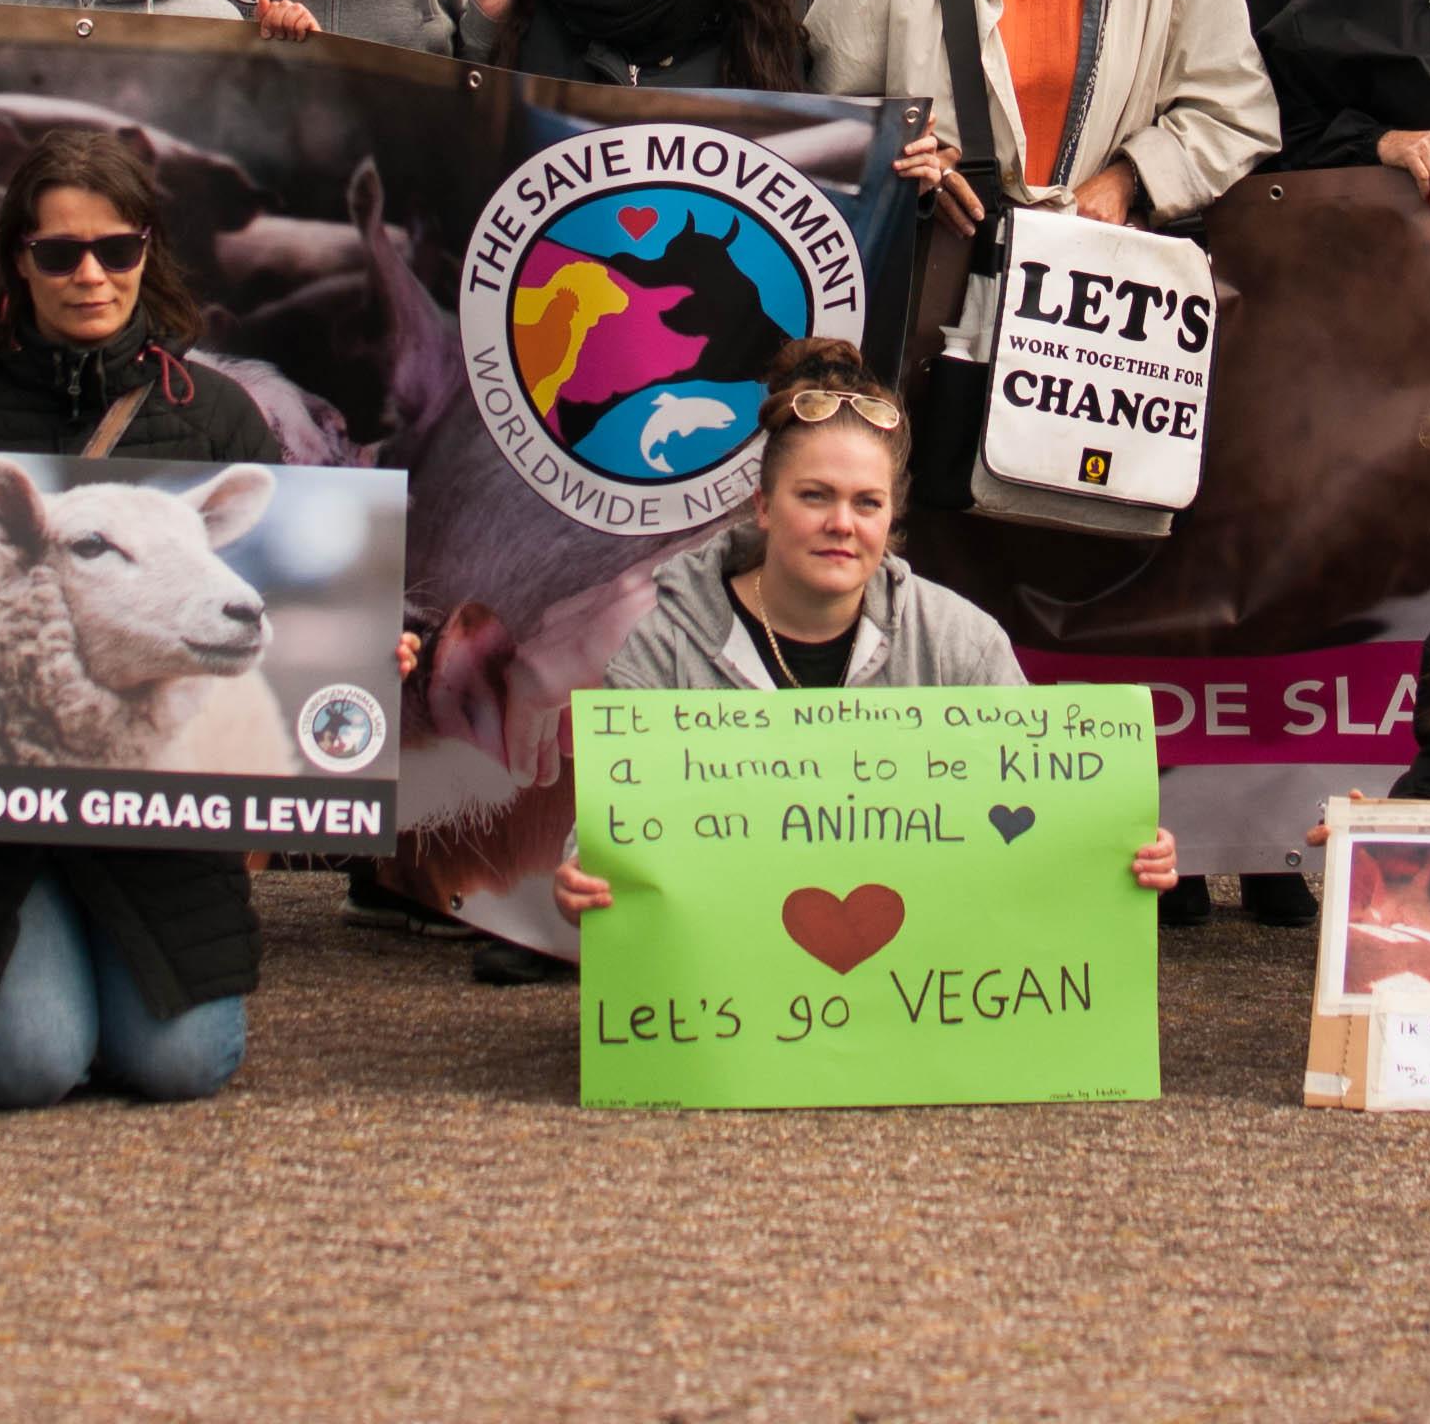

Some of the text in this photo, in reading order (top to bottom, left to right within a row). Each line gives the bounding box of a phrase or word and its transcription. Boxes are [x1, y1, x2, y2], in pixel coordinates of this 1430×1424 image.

[469, 135, 857, 313] THE SAVE MOVEMENT
[1014, 260, 1211, 354] LET'S
[1009, 335, 1204, 388] WORK TOGETHER FOR
[1002, 369, 1198, 440] CHANGE
[472, 346, 661, 527] WORLDWIDE
[592, 703, 651, 737] It
[673, 703, 772, 733] takes
[943, 703, 1049, 738] away
[608, 755, 643, 786] a
[683, 747, 823, 783] human
[853, 749, 898, 782] to
[927, 748, 969, 781] be
[79, 790, 231, 830] GRAAG
[244, 797, 381, 835] LEVEN
[608, 803, 664, 846] to
[694, 811, 751, 840] an
[776, 993, 851, 1042] go
[890, 962, 1093, 1026] VEGAN
[1400, 1022, 1419, 1036] IK
